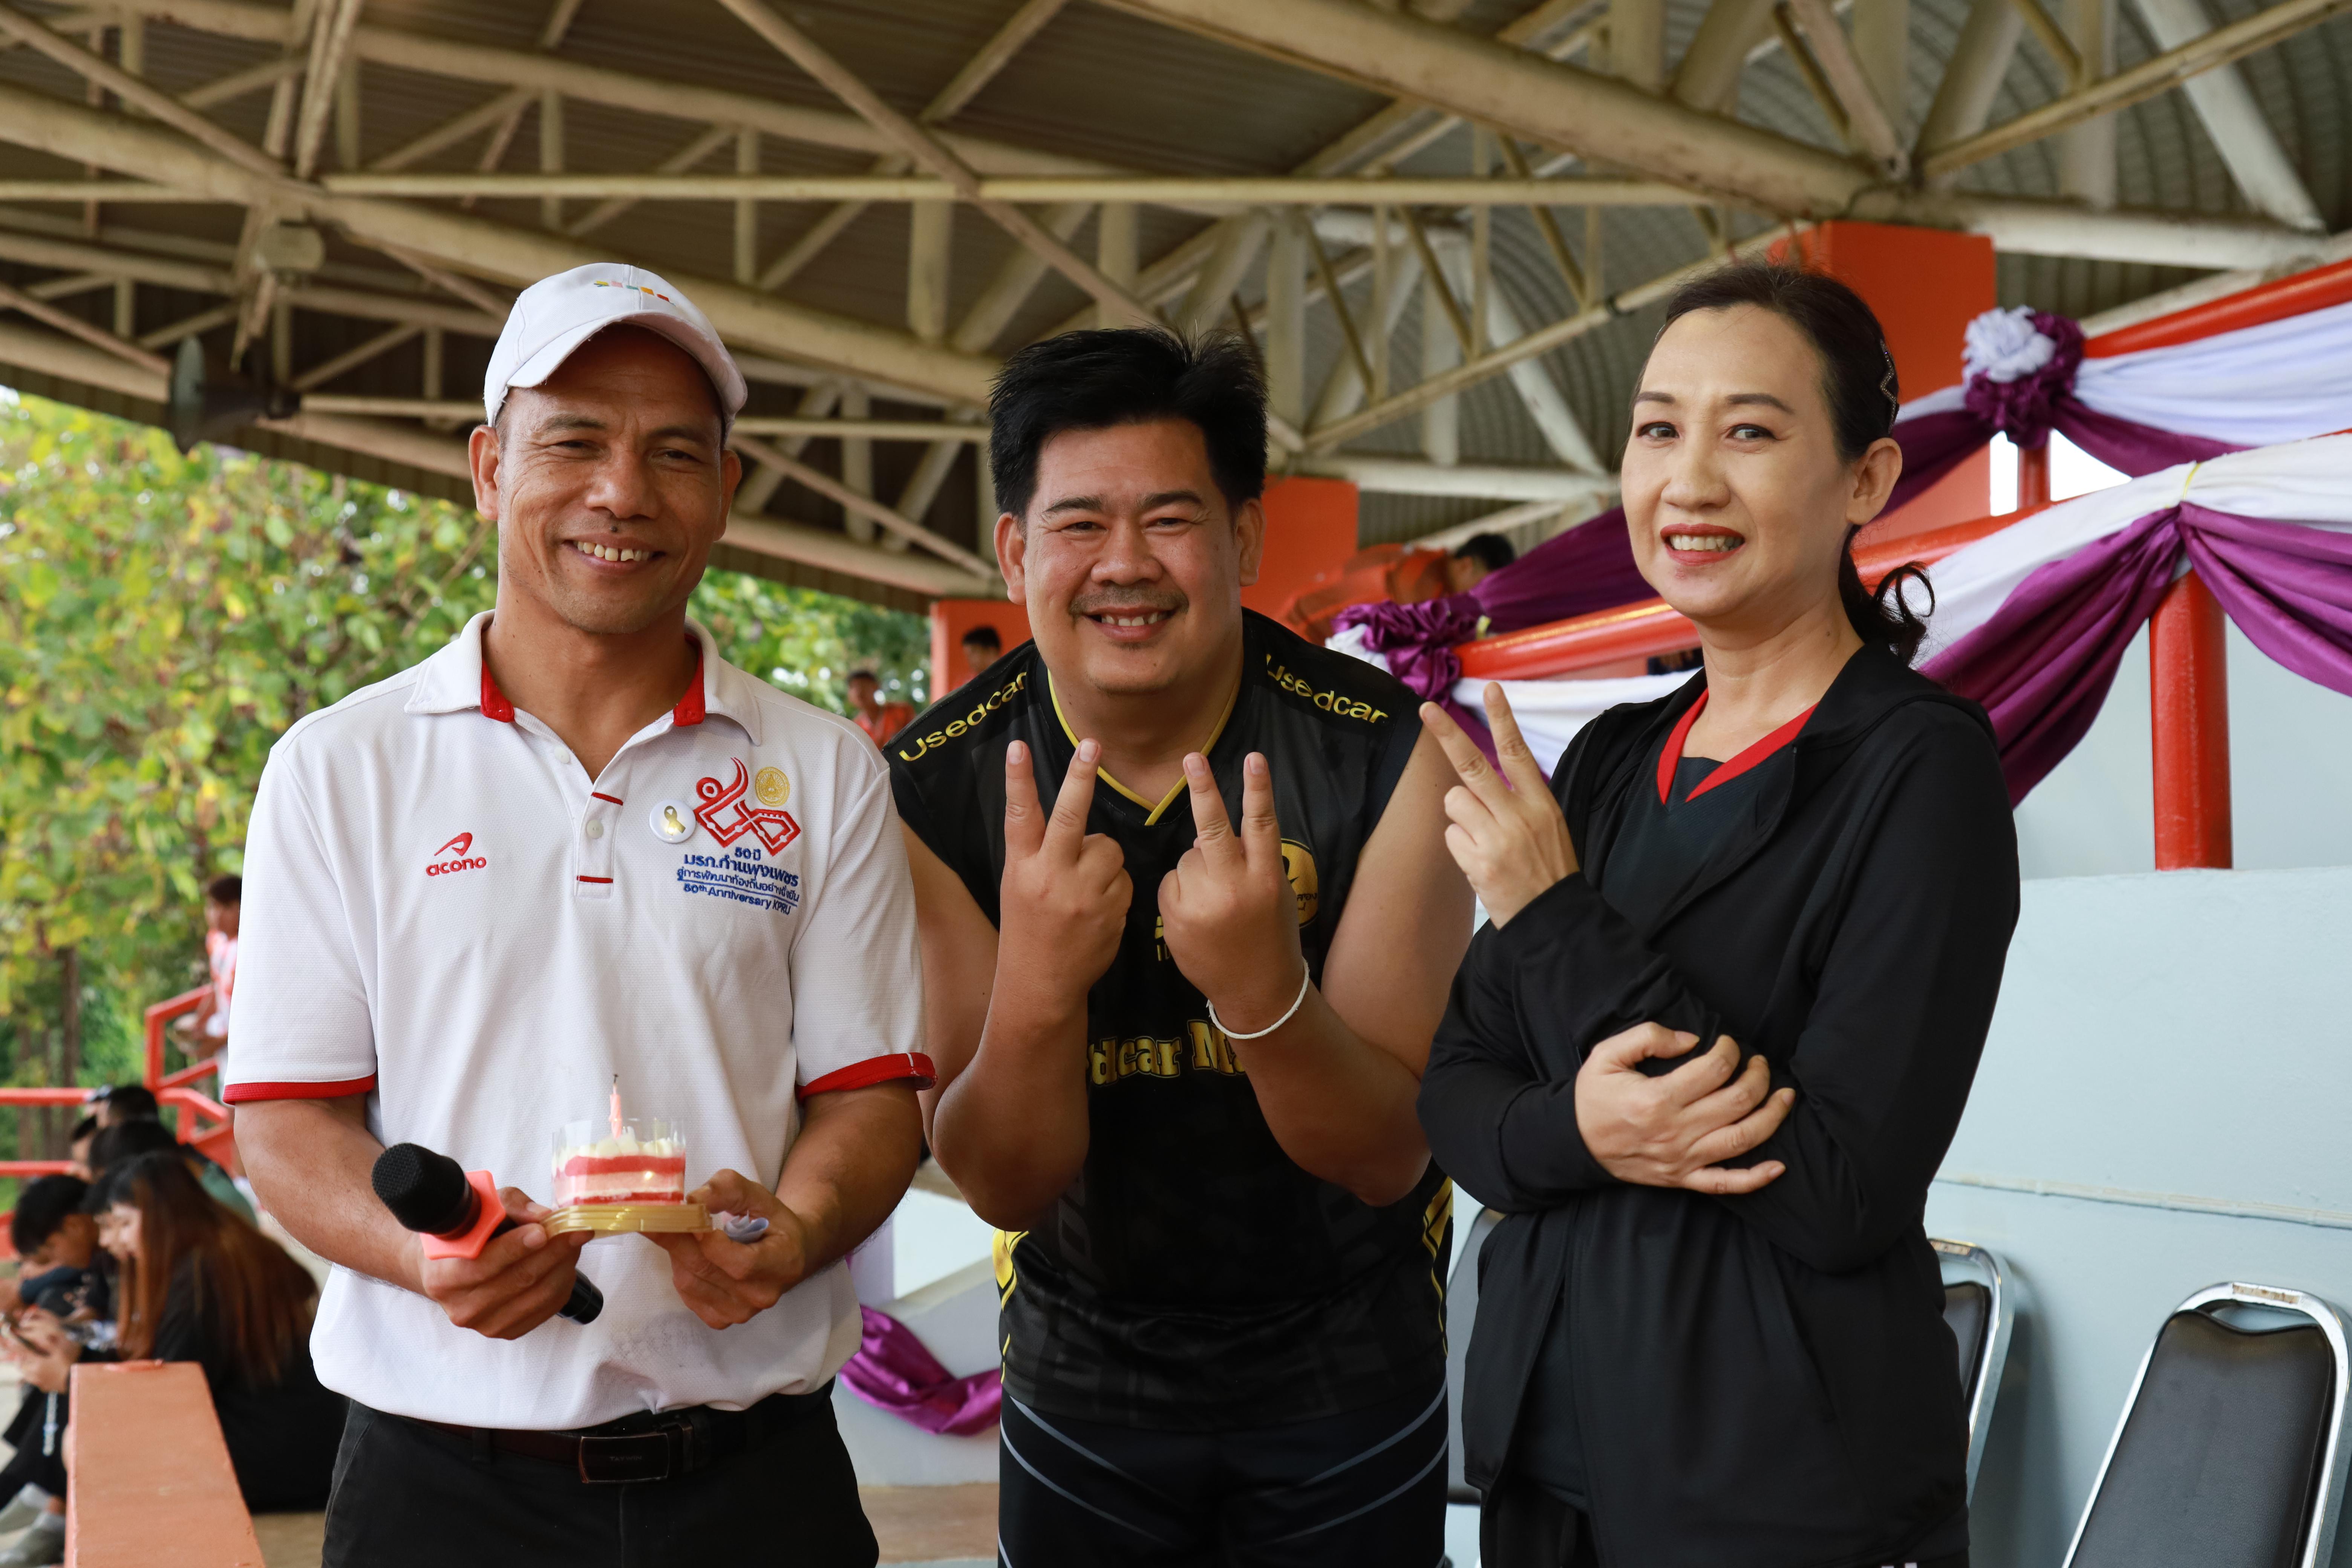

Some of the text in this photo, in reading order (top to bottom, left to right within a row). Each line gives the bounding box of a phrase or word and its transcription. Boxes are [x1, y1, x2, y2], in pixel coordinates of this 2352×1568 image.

[1266, 654, 1389, 723] Usedcar
[899, 672, 1027, 761] Usedcar
[426, 857, 487, 876] acono
[683, 883, 791, 915] 50th Anniversary KPRU
[1087, 1036, 1182, 1086] dcar
